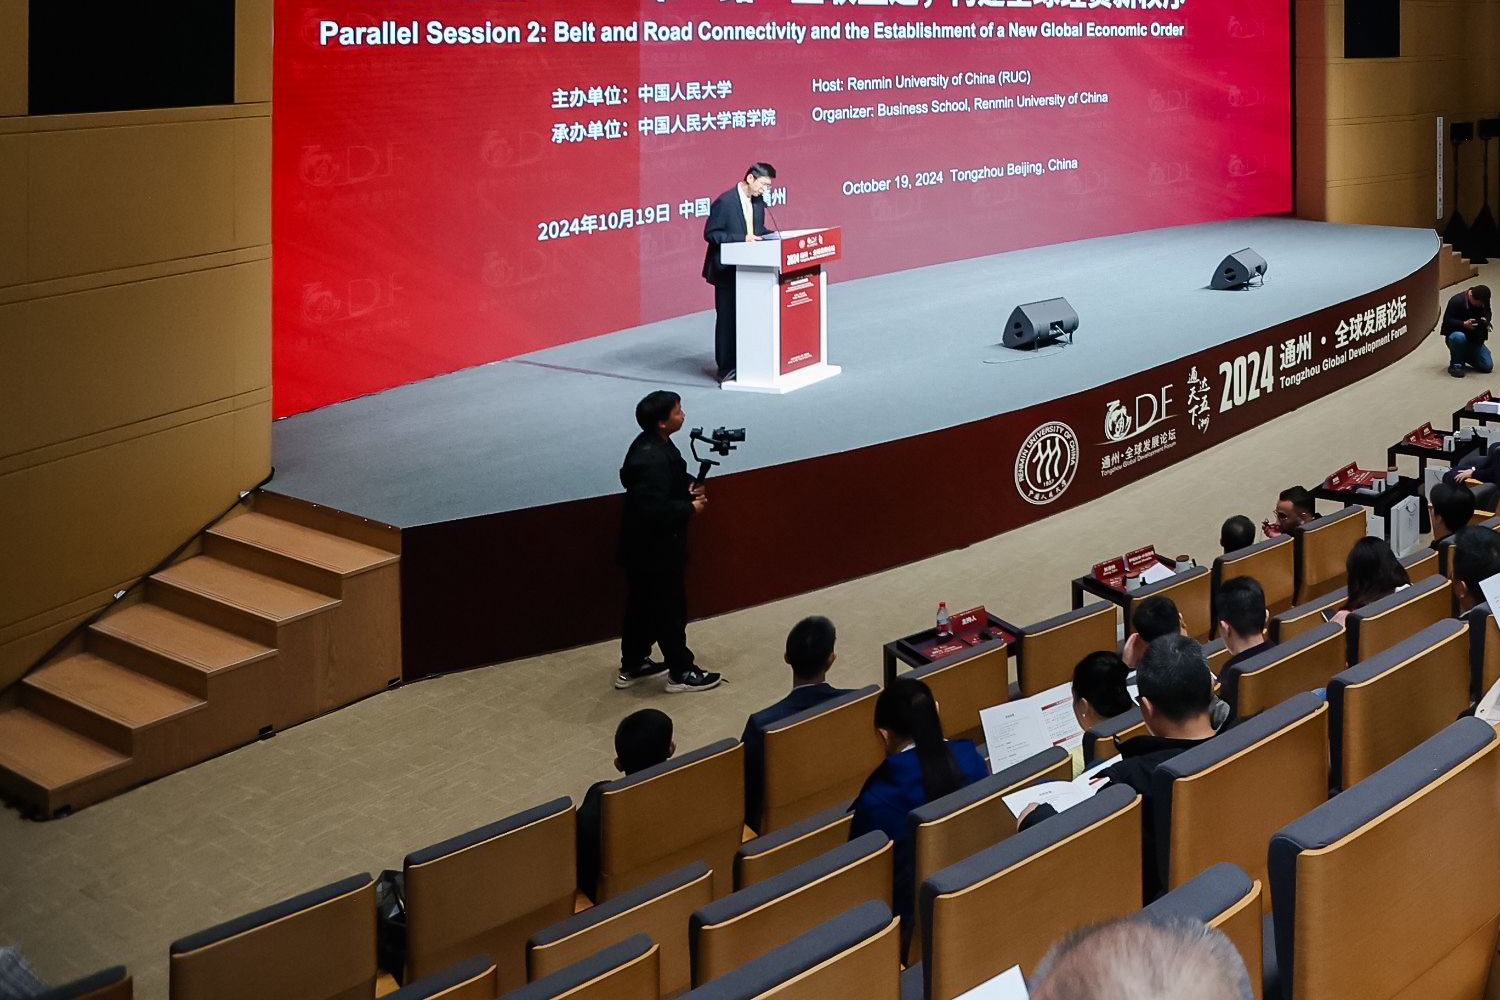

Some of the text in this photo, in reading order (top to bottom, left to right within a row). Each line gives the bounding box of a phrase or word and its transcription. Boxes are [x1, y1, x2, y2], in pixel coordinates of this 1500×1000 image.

[320, 20, 1185, 46] Parallel Session 2: Belt and Road Connectivity and the Establishment of a New Global Economic Order
[812, 70, 1031, 93] Host: Renmin University of China (RUC)
[811, 91, 1109, 124] Organizer: Business School, Renmin University of China
[842, 157, 1078, 197] October 19, 2024 Tongzhou Beijing, China
[537, 203, 671, 241] 2024年10月19日
[1280, 324, 1408, 389] Tongzhou Global Development Forum
[1218, 345, 1274, 414] 2024
[1018, 425, 1077, 482] RENMIN UNIVERSITY OF CHINA
